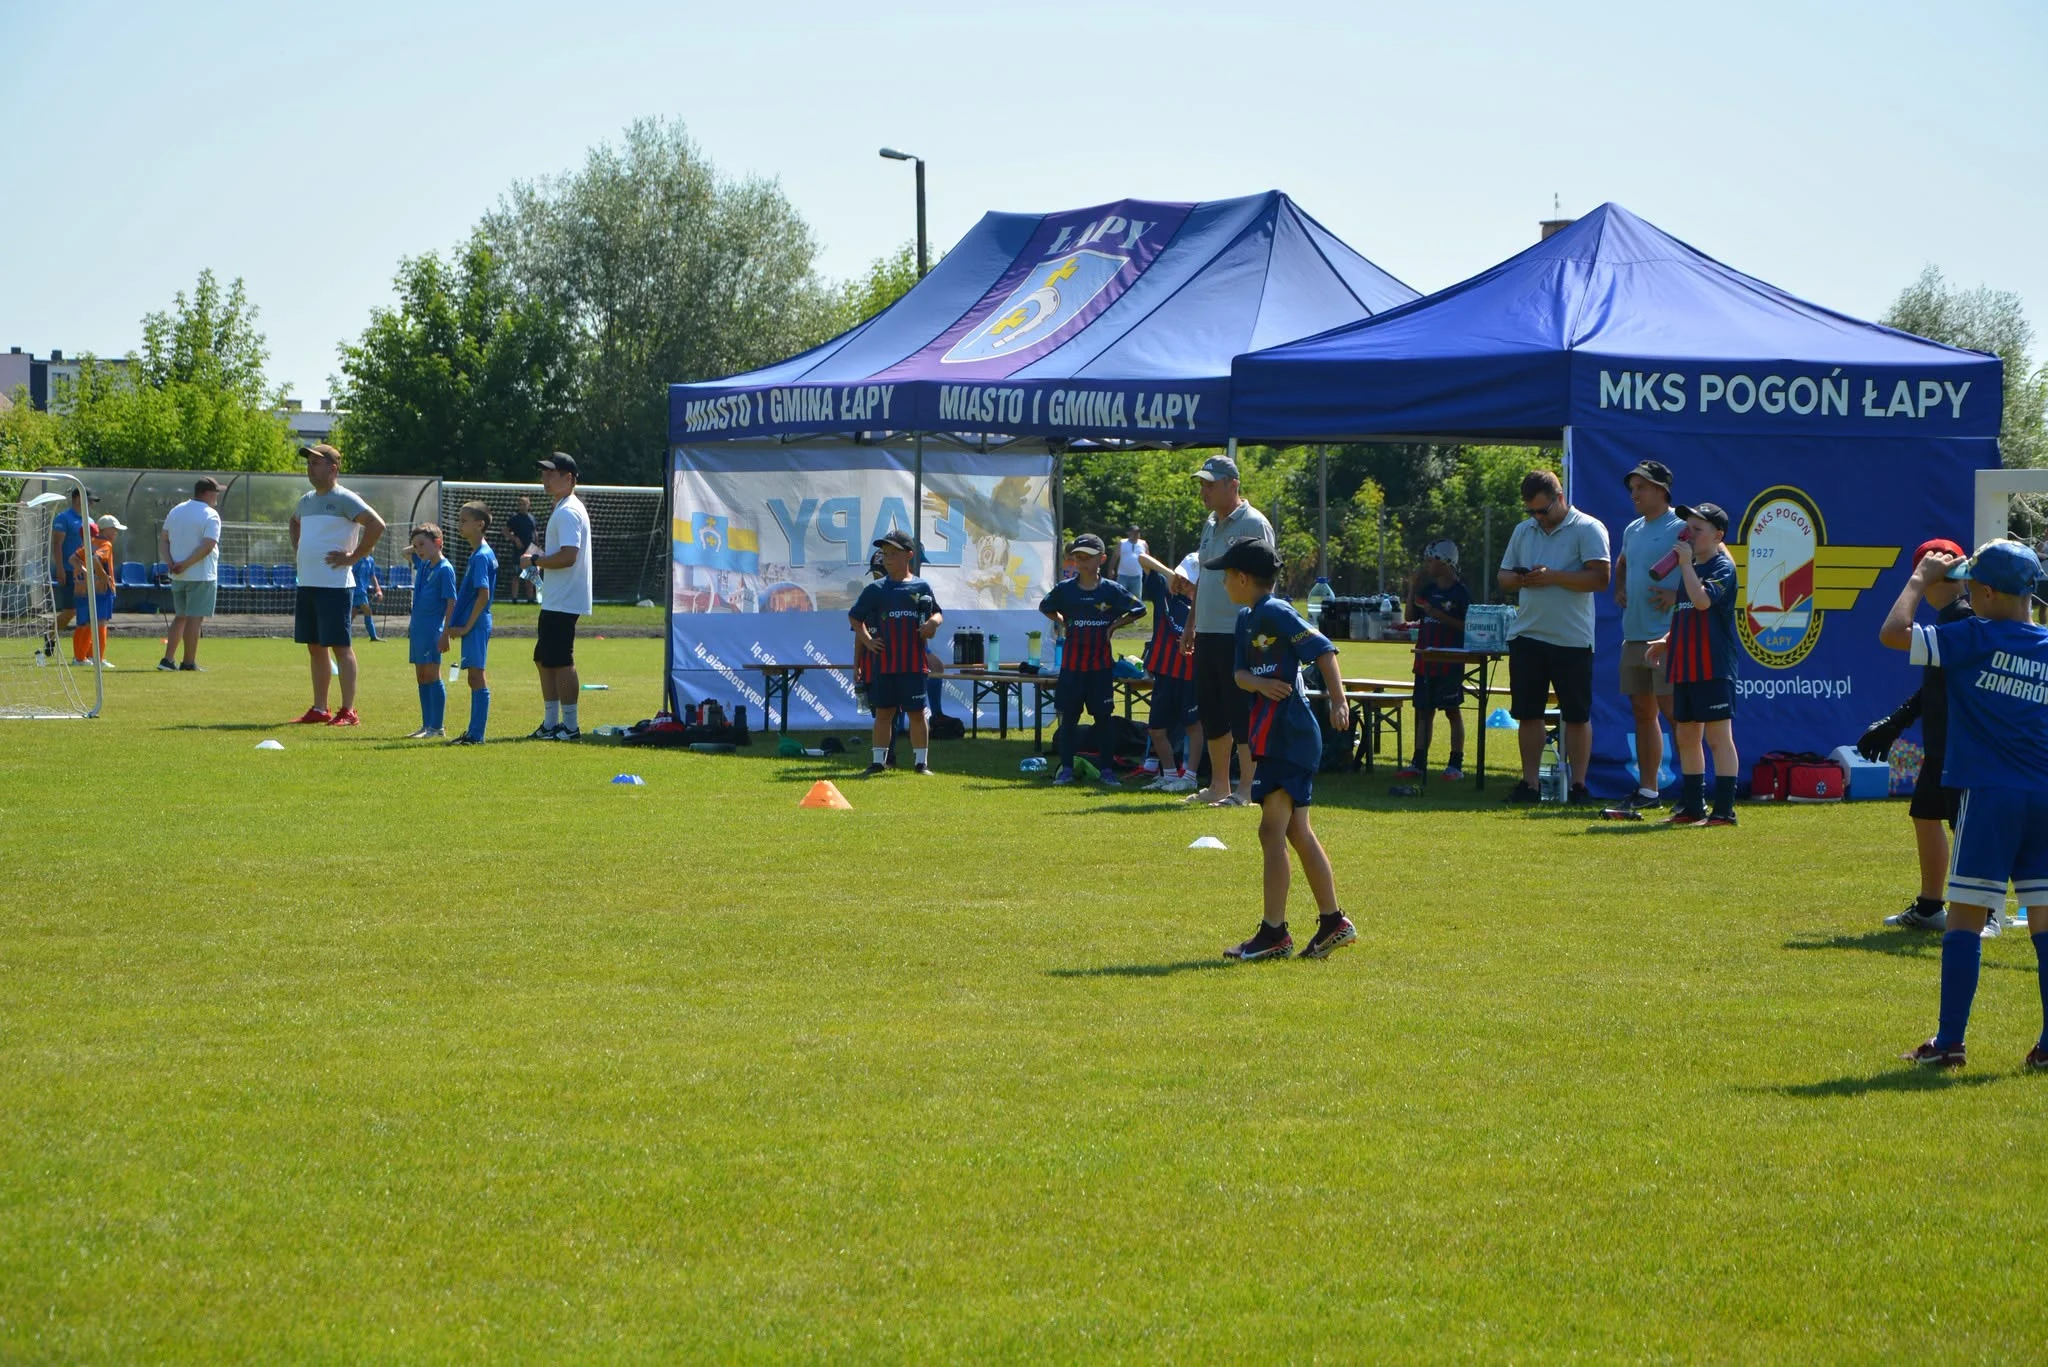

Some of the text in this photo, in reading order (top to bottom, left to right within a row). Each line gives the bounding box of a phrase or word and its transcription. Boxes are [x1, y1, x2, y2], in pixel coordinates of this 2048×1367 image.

[1044, 216, 1158, 255] ŁAPY
[685, 385, 894, 432] MIASTO I GMINA ŁAPY
[939, 385, 1200, 429] MIASTO I GMINA ŁAPY
[1600, 368, 1971, 419] MKS POGOŃ ŁAPY
[1754, 512, 1773, 536] MKS
[1751, 549, 1774, 558] 1927
[1991, 650, 2048, 681] OLIMPI
